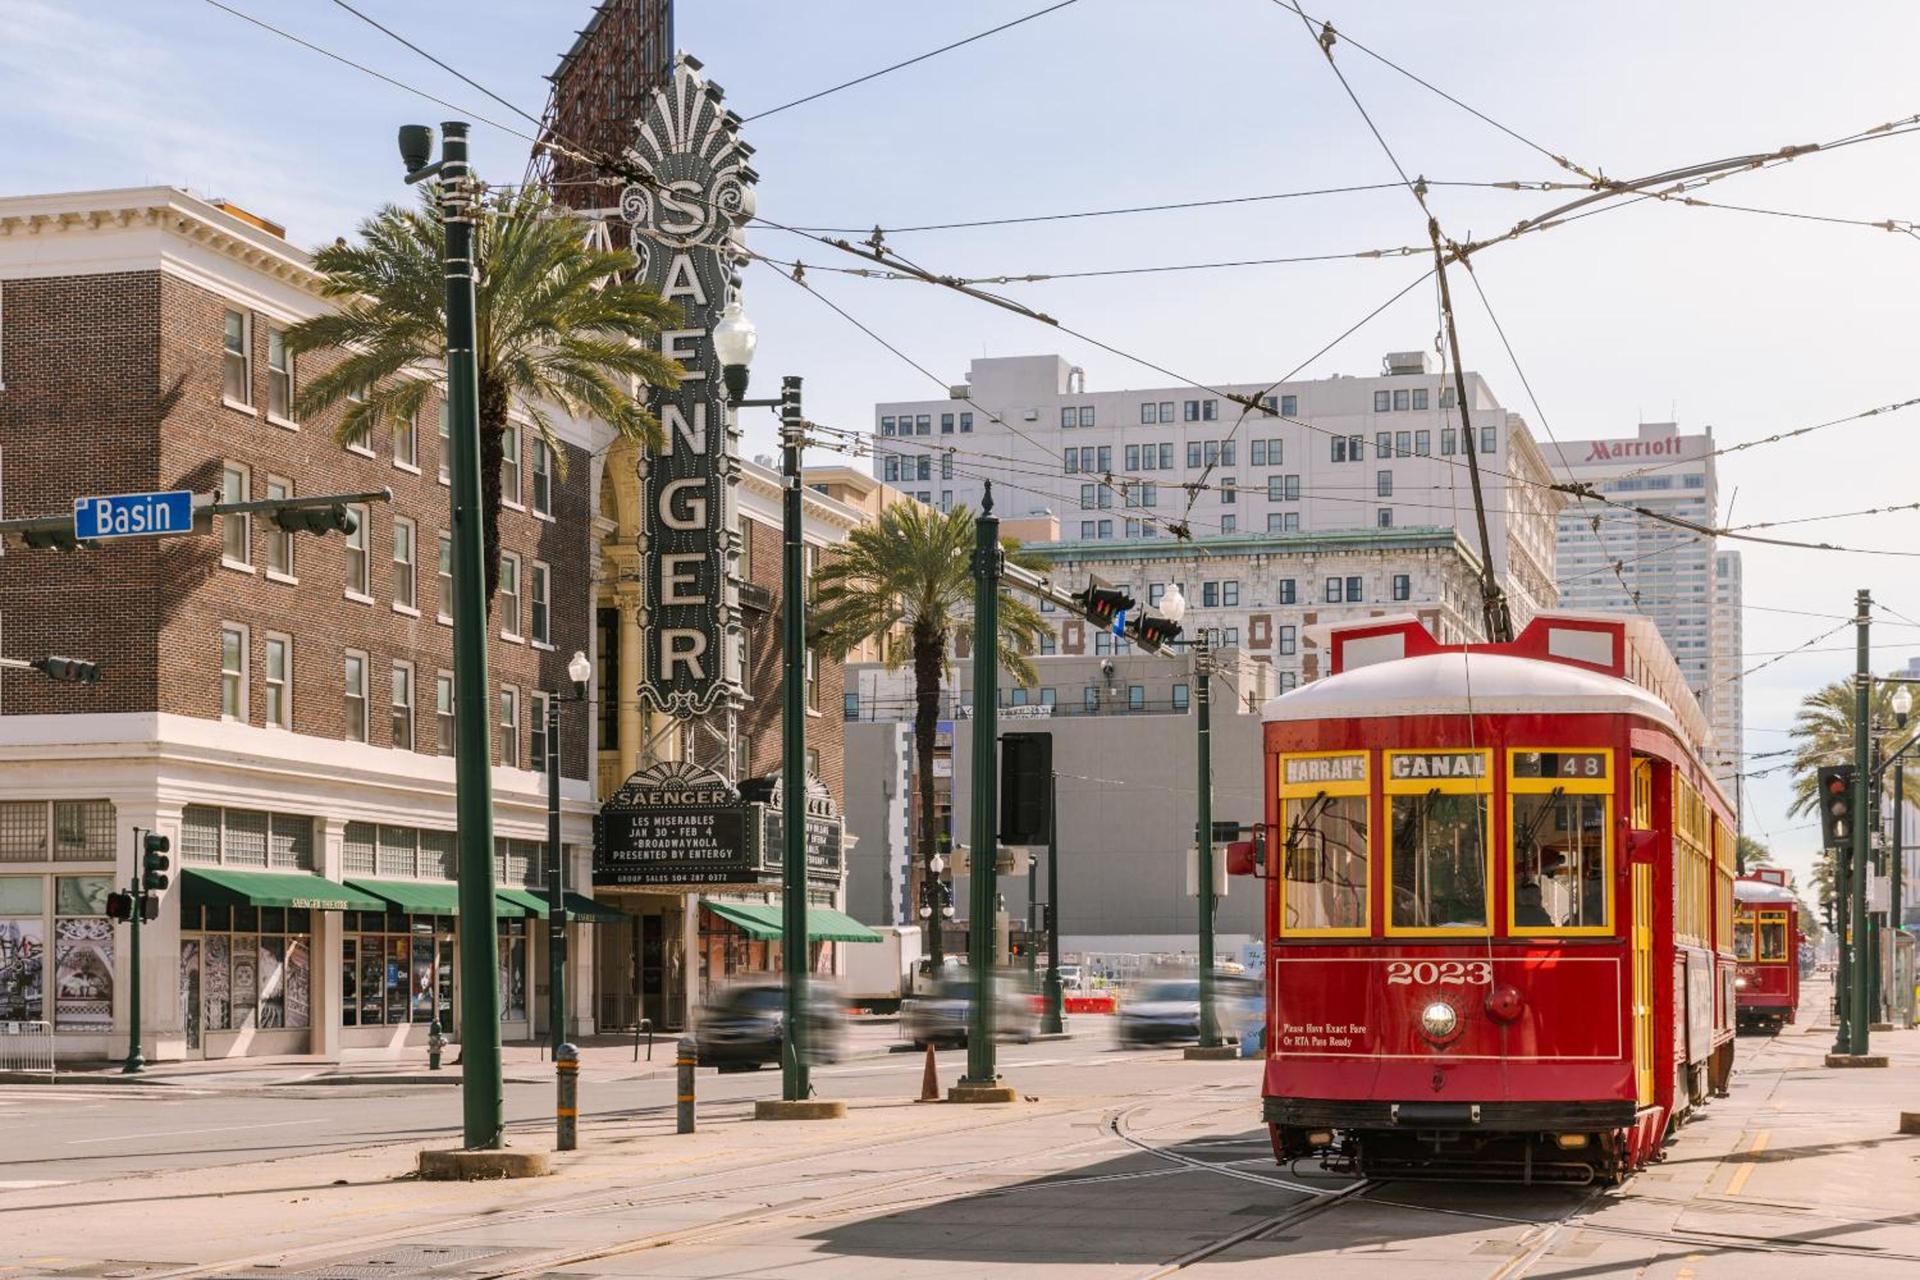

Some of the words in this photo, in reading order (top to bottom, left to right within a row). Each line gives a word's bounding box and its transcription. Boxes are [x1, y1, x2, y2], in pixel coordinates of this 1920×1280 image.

[659, 180, 707, 681] SAENGER
[1585, 436, 1682, 462] Marriott
[96, 496, 170, 534] Basin
[1392, 755, 1486, 777] CANAL
[1563, 757, 1599, 776] 48
[618, 790, 727, 806] SAENGER
[632, 817, 649, 827] LES
[654, 815, 715, 826] MISERABLES
[629, 828, 647, 838] JAN
[655, 828, 668, 837] 30
[680, 827, 698, 837] FEB
[706, 827, 712, 837] 4
[613, 850, 668, 860] PRESENTED
[671, 850, 684, 859] BY
[690, 849, 733, 859] ENTERGY
[645, 874, 668, 882] SALES
[1387, 962, 1492, 985] 2023
[1283, 1023, 1304, 1034] Please
[1306, 1023, 1323, 1034] Have
[1326, 1023, 1347, 1034] Exact
[1350, 1023, 1367, 1034] Fare
[1283, 1036, 1293, 1046] Or
[1295, 1036, 1309, 1046] RTA
[1311, 1036, 1327, 1047] Pass
[1329, 1036, 1353, 1048] Ready
